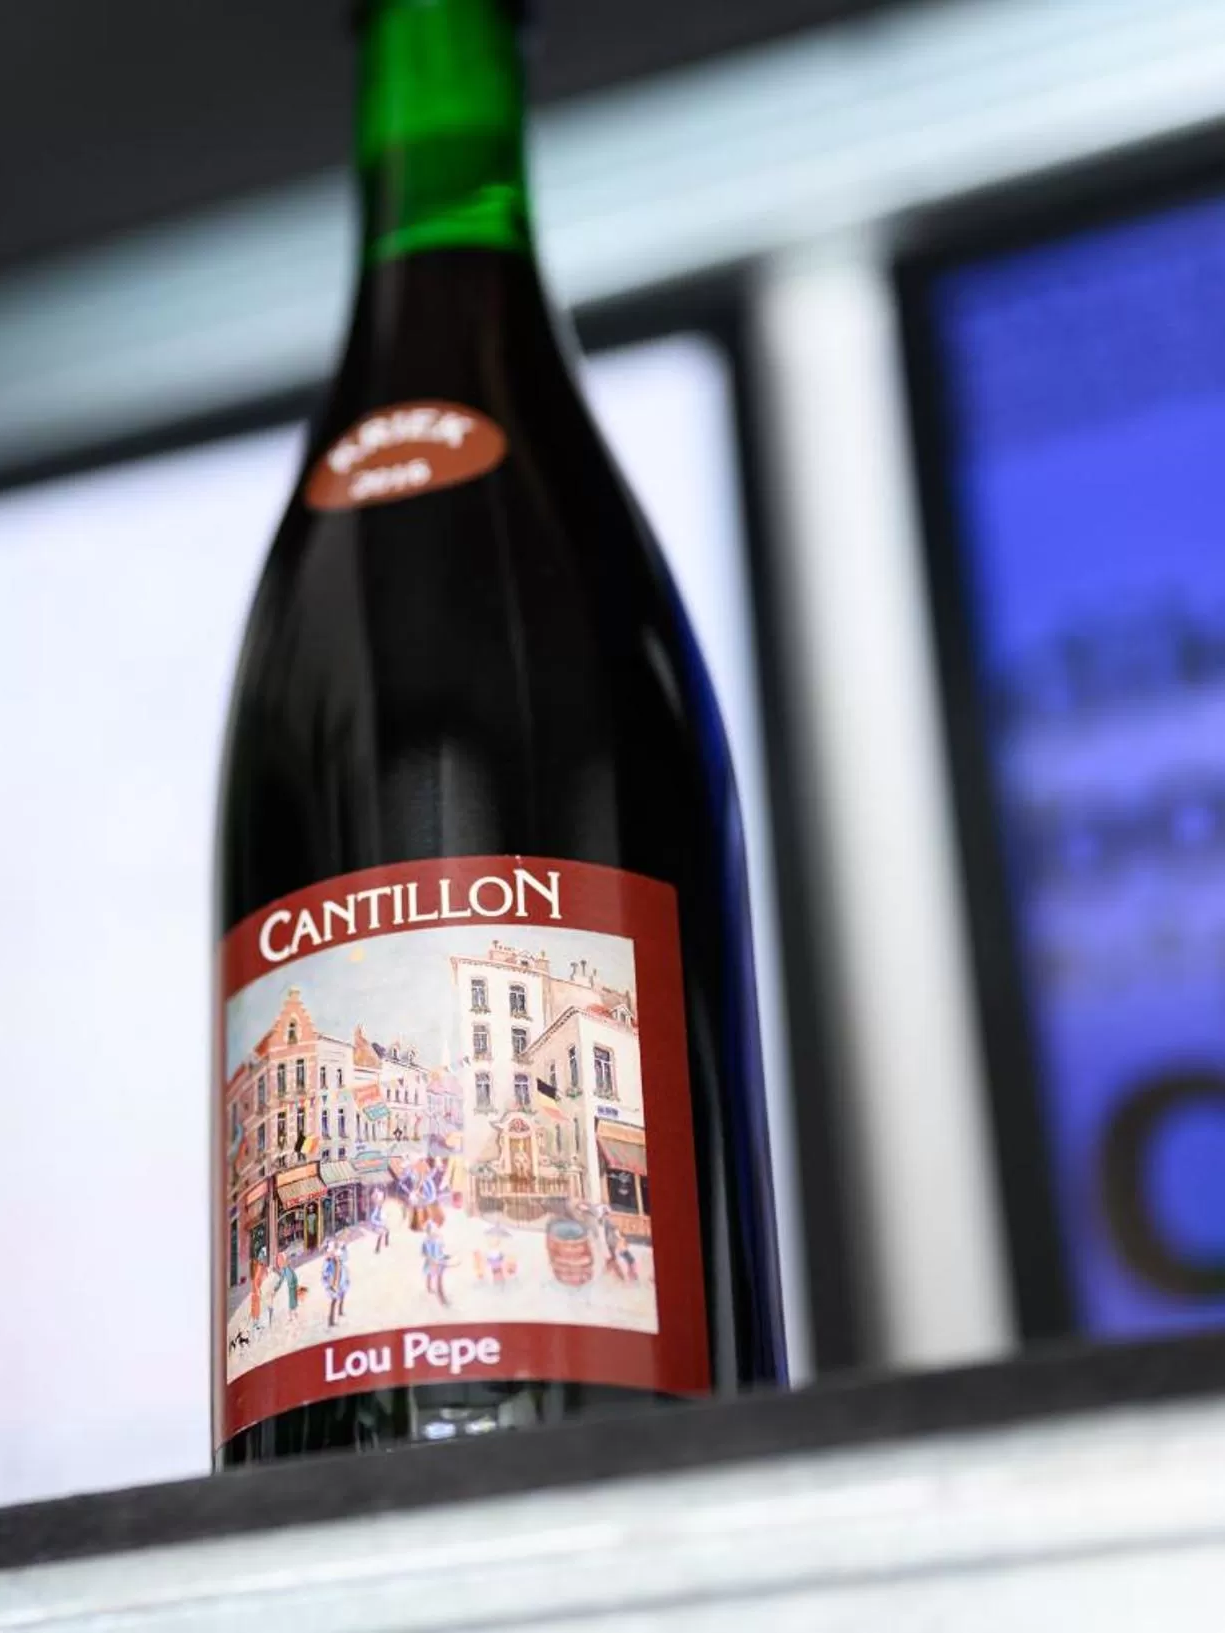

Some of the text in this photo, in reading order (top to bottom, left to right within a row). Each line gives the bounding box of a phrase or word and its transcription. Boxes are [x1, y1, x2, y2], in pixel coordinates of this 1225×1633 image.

[259, 867, 562, 963] CANTILLON
[325, 1331, 501, 1383] Lou Pepe
